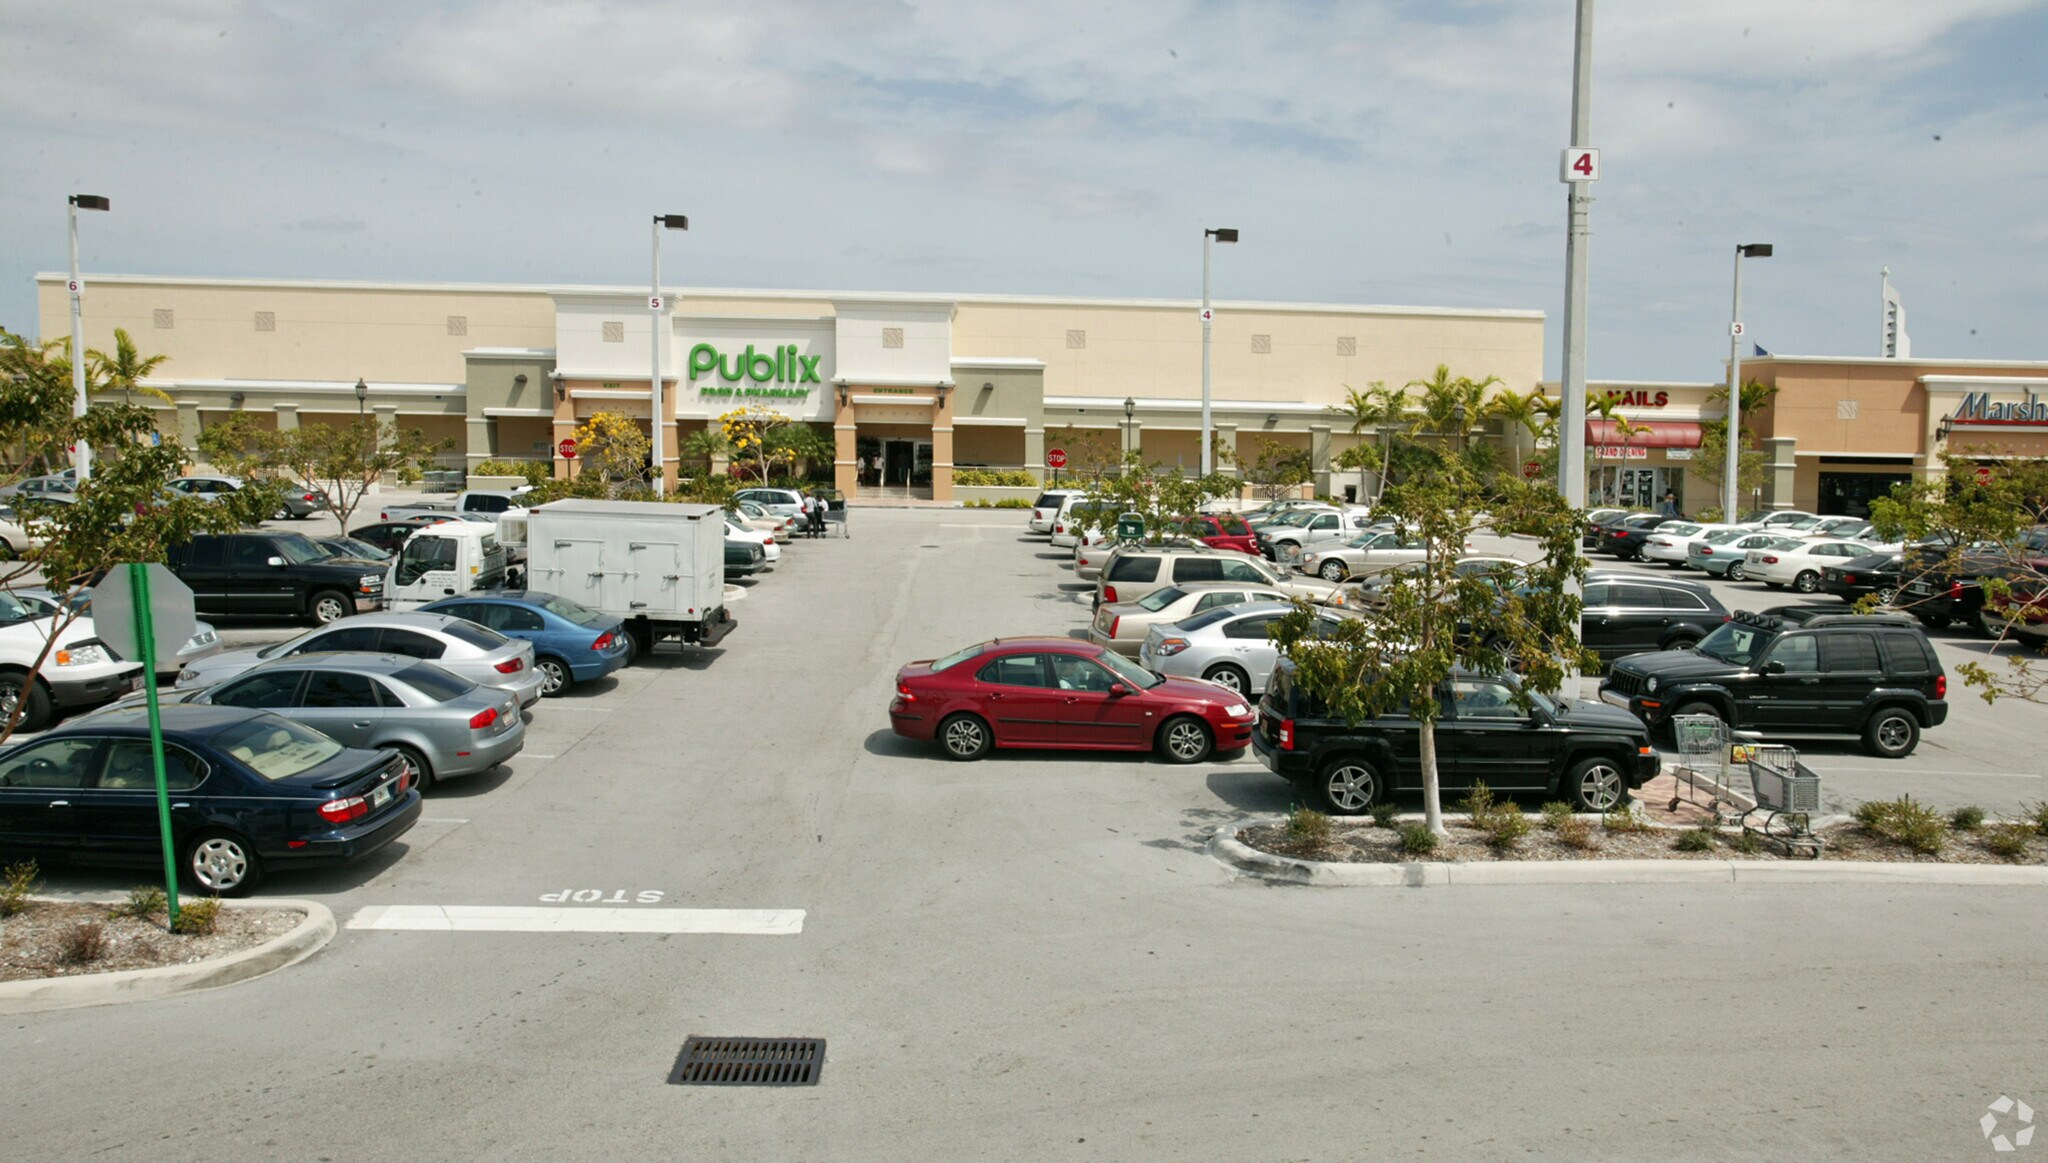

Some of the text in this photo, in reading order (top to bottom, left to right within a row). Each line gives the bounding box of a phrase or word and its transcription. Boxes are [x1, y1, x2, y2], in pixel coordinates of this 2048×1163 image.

[1573, 153, 1593, 176] 4
[69, 281, 77, 291] 6
[651, 298, 660, 308] 5
[1203, 310, 1211, 320] 4
[1734, 324, 1742, 334] 3
[689, 342, 821, 383] Publix
[700, 387, 733, 397] FOOD
[744, 388, 810, 398] PHARMACY
[1952, 391, 2048, 420] Marsh
[559, 444, 576, 453] STO
[1048, 454, 1066, 463] STOP
[538, 889, 665, 903] STOP
